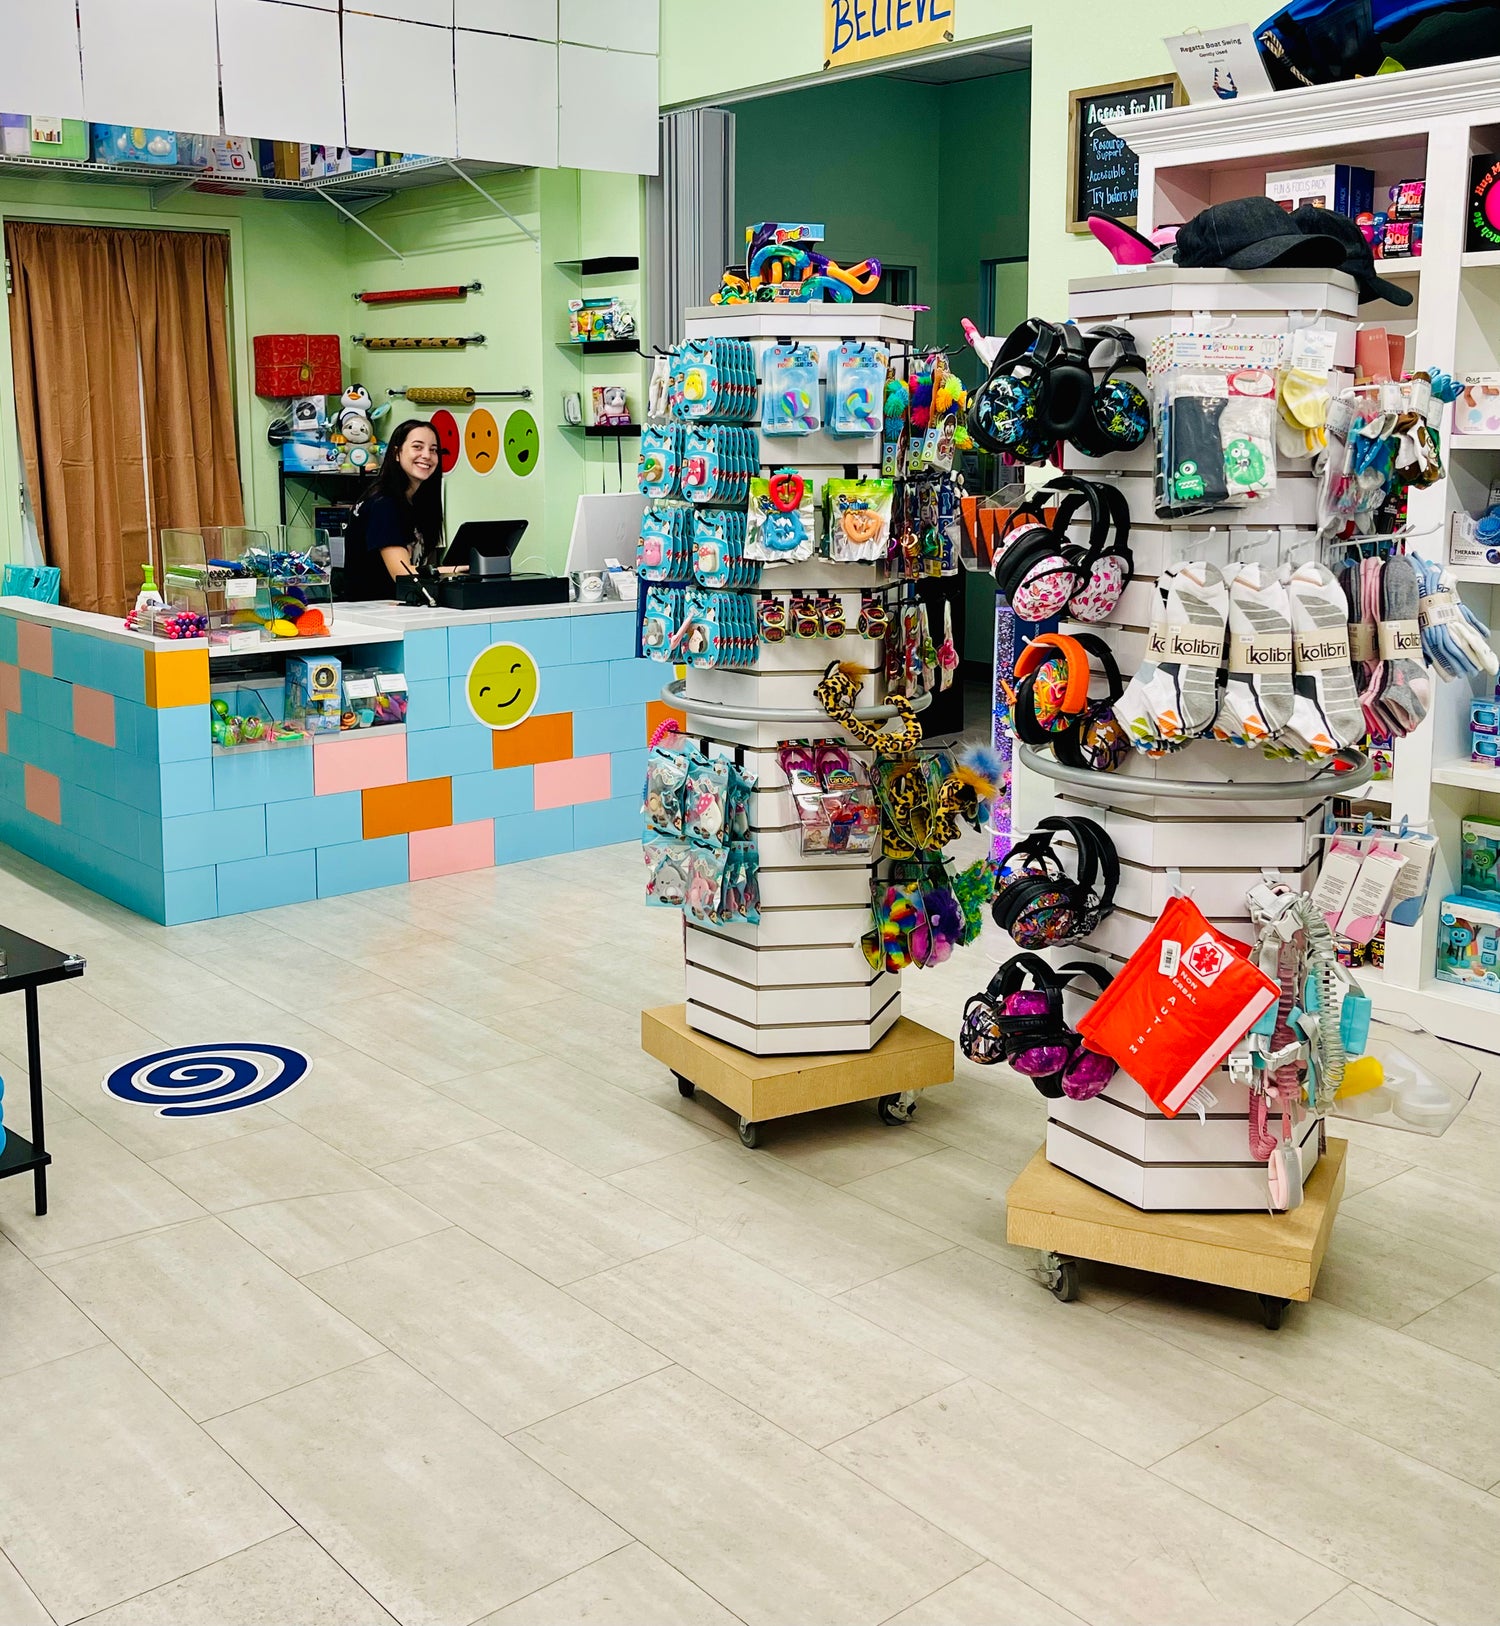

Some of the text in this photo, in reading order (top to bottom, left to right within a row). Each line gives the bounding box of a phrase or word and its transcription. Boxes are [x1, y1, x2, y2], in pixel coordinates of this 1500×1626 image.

[1180, 38, 1242, 54] Regatta Boat Swing
[1087, 94, 1167, 124] Access for All
[1092, 138, 1125, 151] Resource
[1096, 150, 1122, 161] Support
[1273, 179, 1327, 195] FUN & FOCUS PACK
[1474, 173, 1493, 197] Hug
[1087, 186, 1105, 210] Try
[1106, 185, 1128, 205] before
[1174, 635, 1220, 655] kolibri
[1300, 643, 1346, 662] kolibri
[1169, 975, 1197, 1005] ERBAL
[1180, 970, 1198, 990] NON
